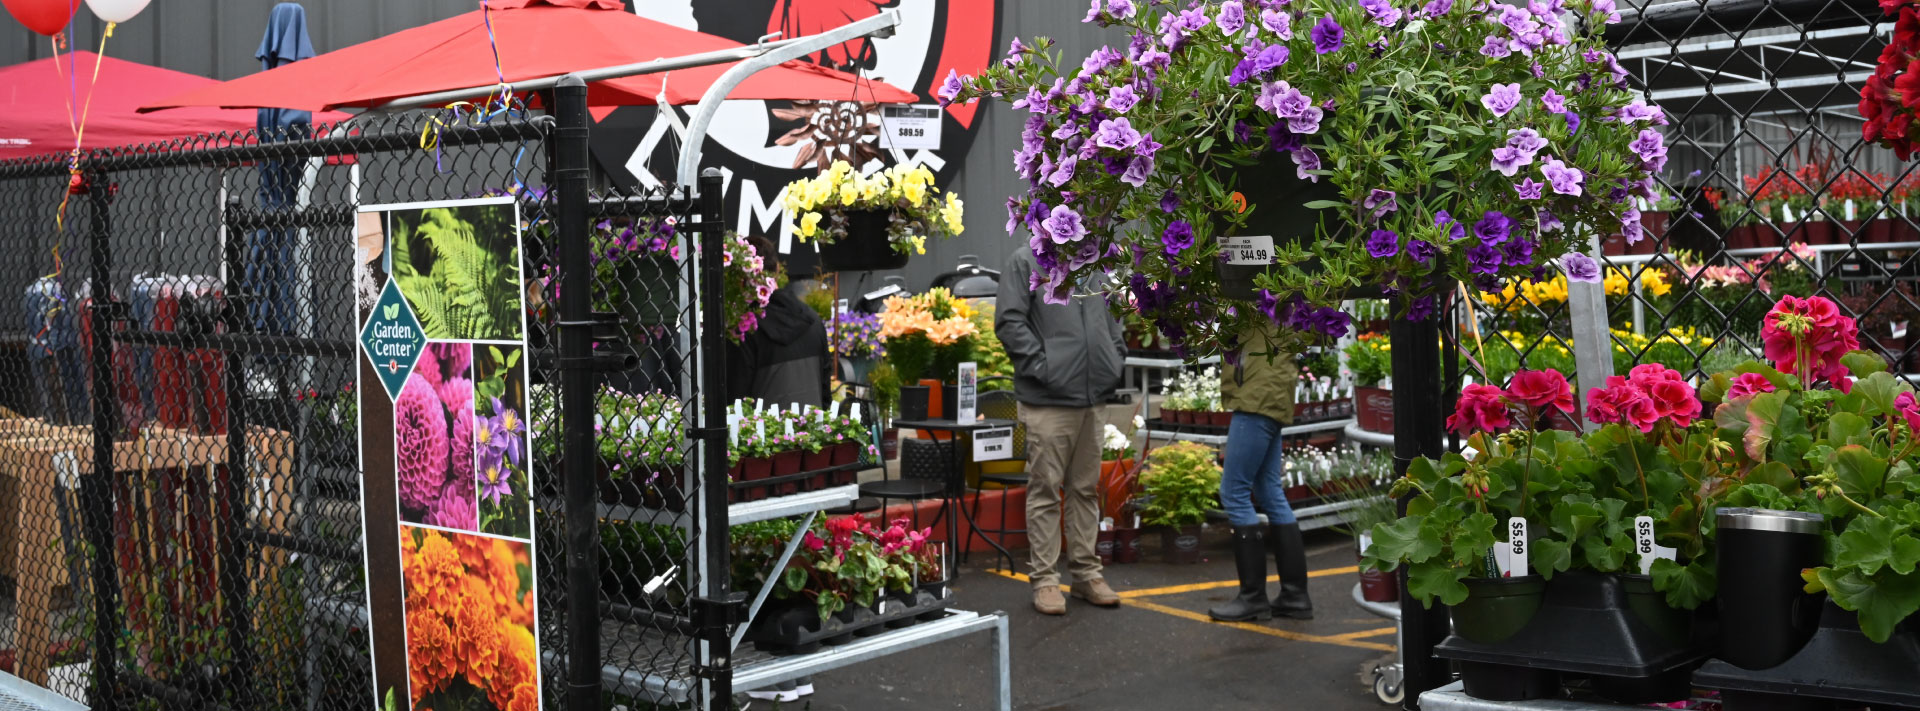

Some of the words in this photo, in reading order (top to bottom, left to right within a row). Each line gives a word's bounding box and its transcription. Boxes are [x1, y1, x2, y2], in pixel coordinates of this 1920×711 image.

[899, 128, 924, 137] $89.59
[1240, 249, 1267, 261] $44.99
[374, 320, 412, 339] Garden
[375, 339, 412, 357] Center
[1511, 521, 1524, 555] $5.99
[1638, 521, 1651, 554] $5.99
